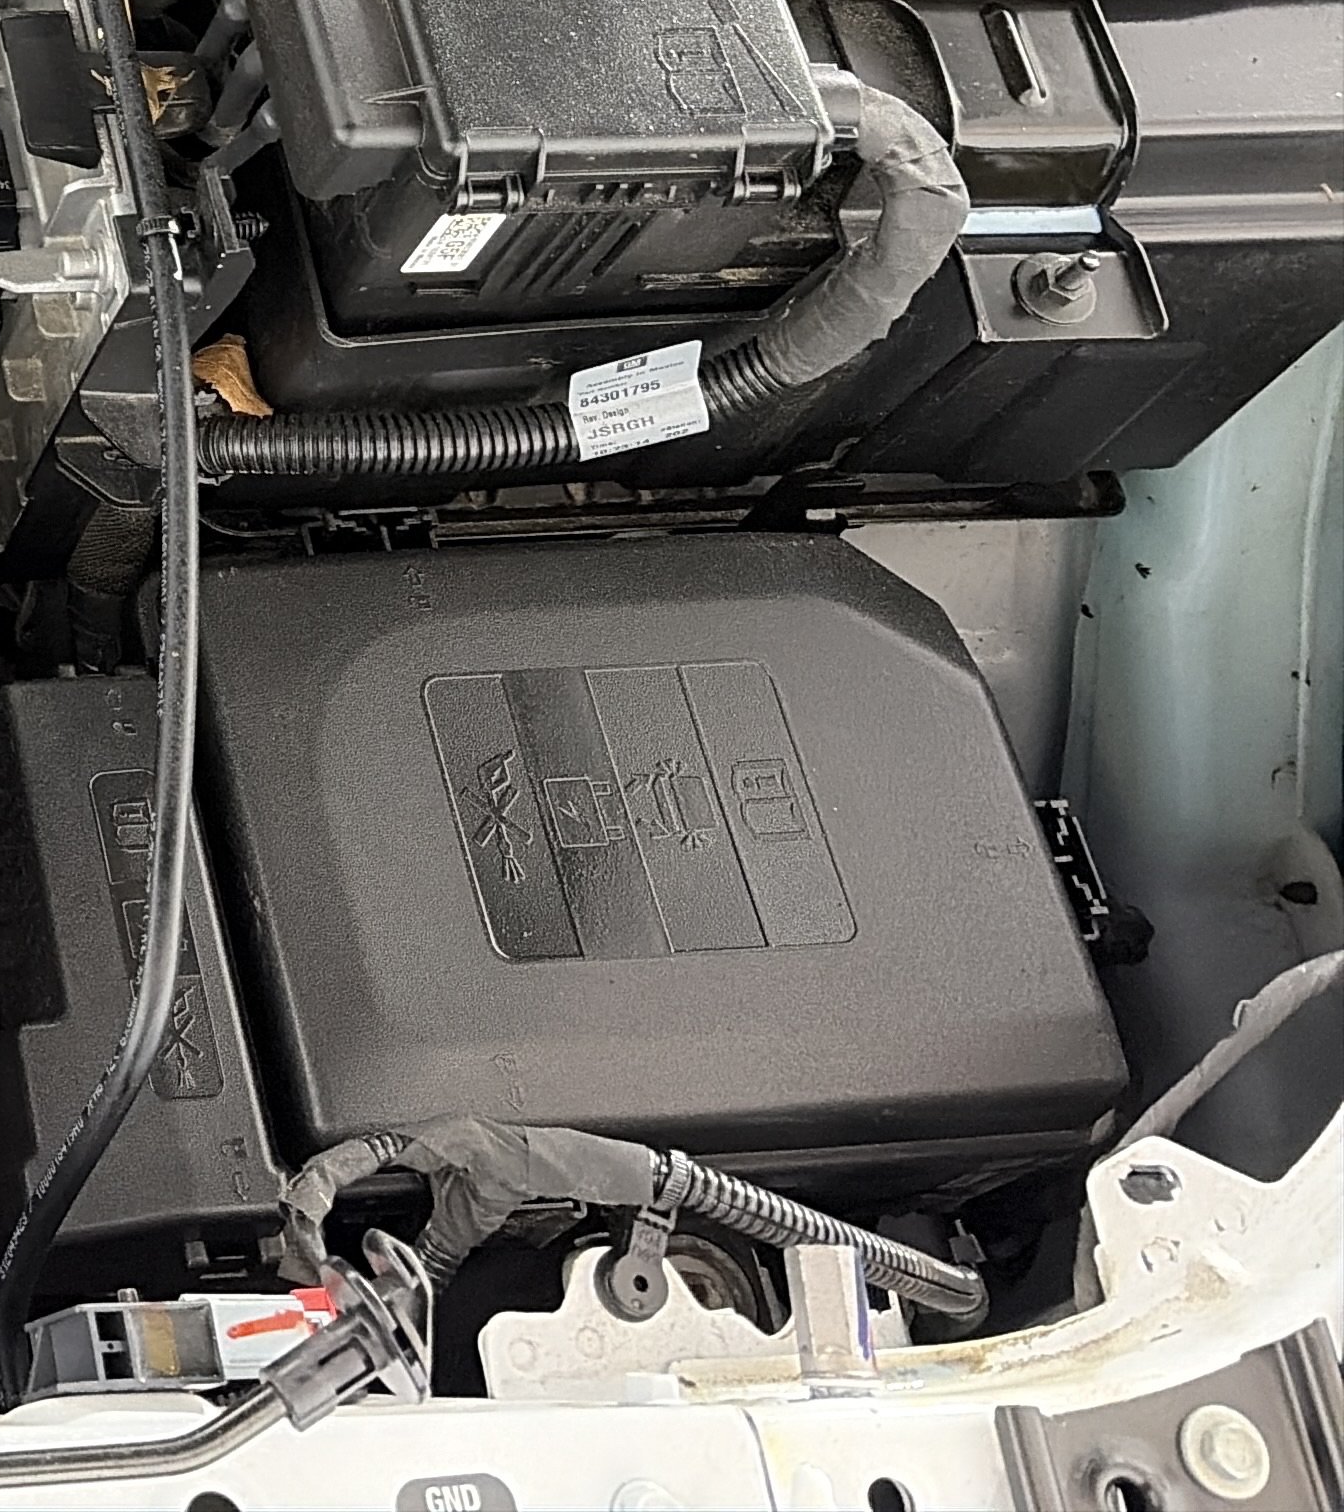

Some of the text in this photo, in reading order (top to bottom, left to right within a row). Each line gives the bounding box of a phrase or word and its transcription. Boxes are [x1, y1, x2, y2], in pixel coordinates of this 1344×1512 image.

[580, 380, 661, 408] 84301795
[588, 415, 655, 440] JSRGH
[425, 1483, 482, 1512] GND
